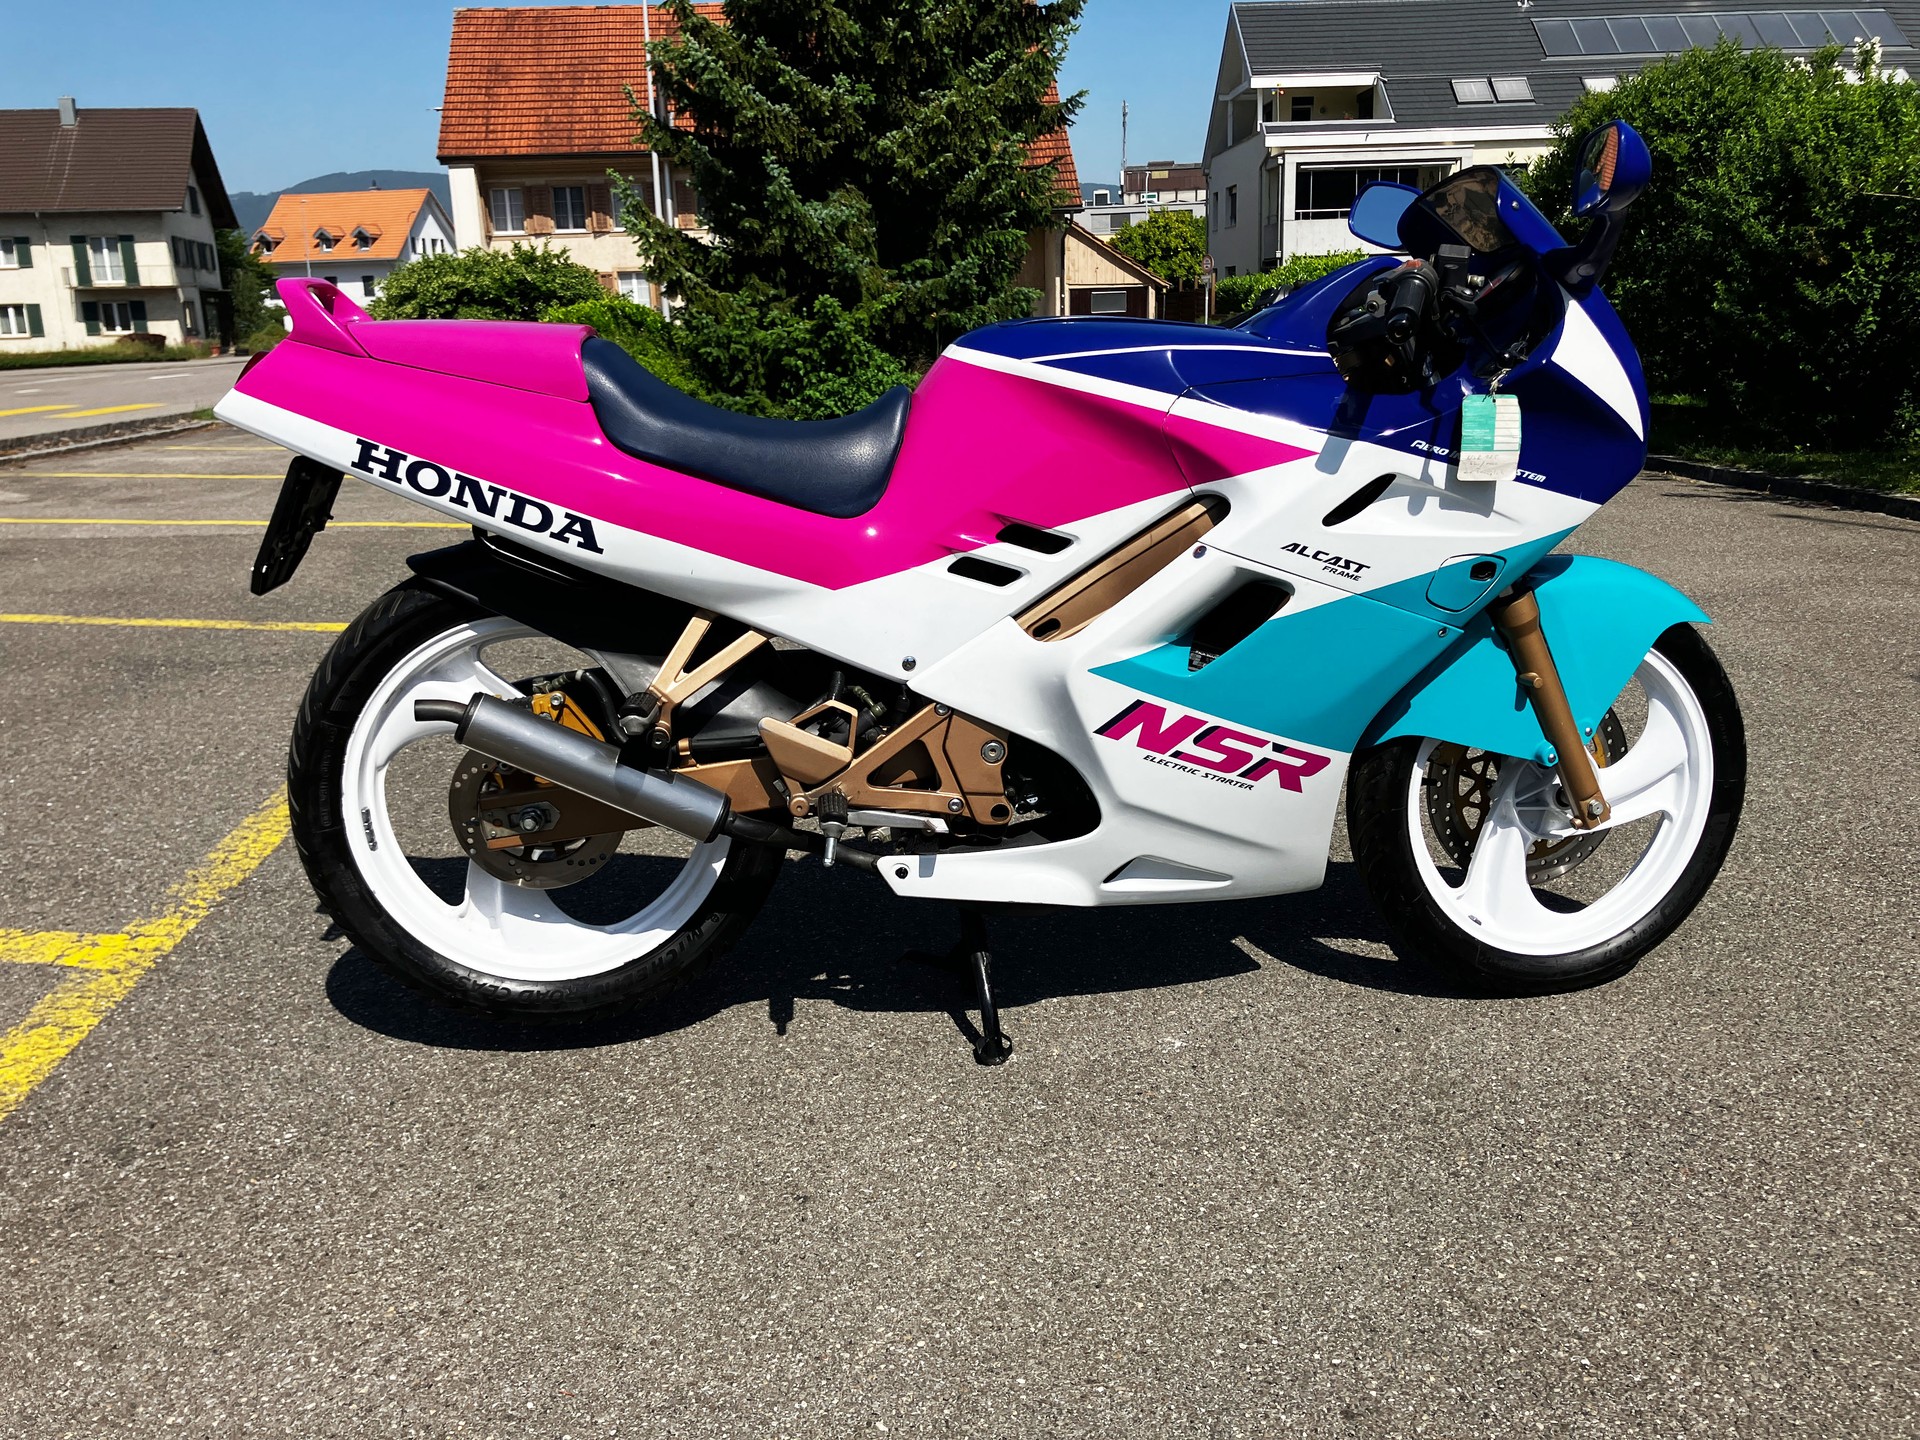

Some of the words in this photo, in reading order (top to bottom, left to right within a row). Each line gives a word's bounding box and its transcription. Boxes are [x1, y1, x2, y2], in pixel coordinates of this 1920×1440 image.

[1410, 439, 1450, 456] AERO
[1515, 468, 1547, 483] STEM
[351, 438, 604, 554] HONDA
[1280, 542, 1371, 573] ALCAST
[1322, 565, 1362, 581] FRAME
[1092, 699, 1331, 793] NSR
[1143, 754, 1200, 775] ELECTRIC
[1201, 772, 1255, 791] STARTER
